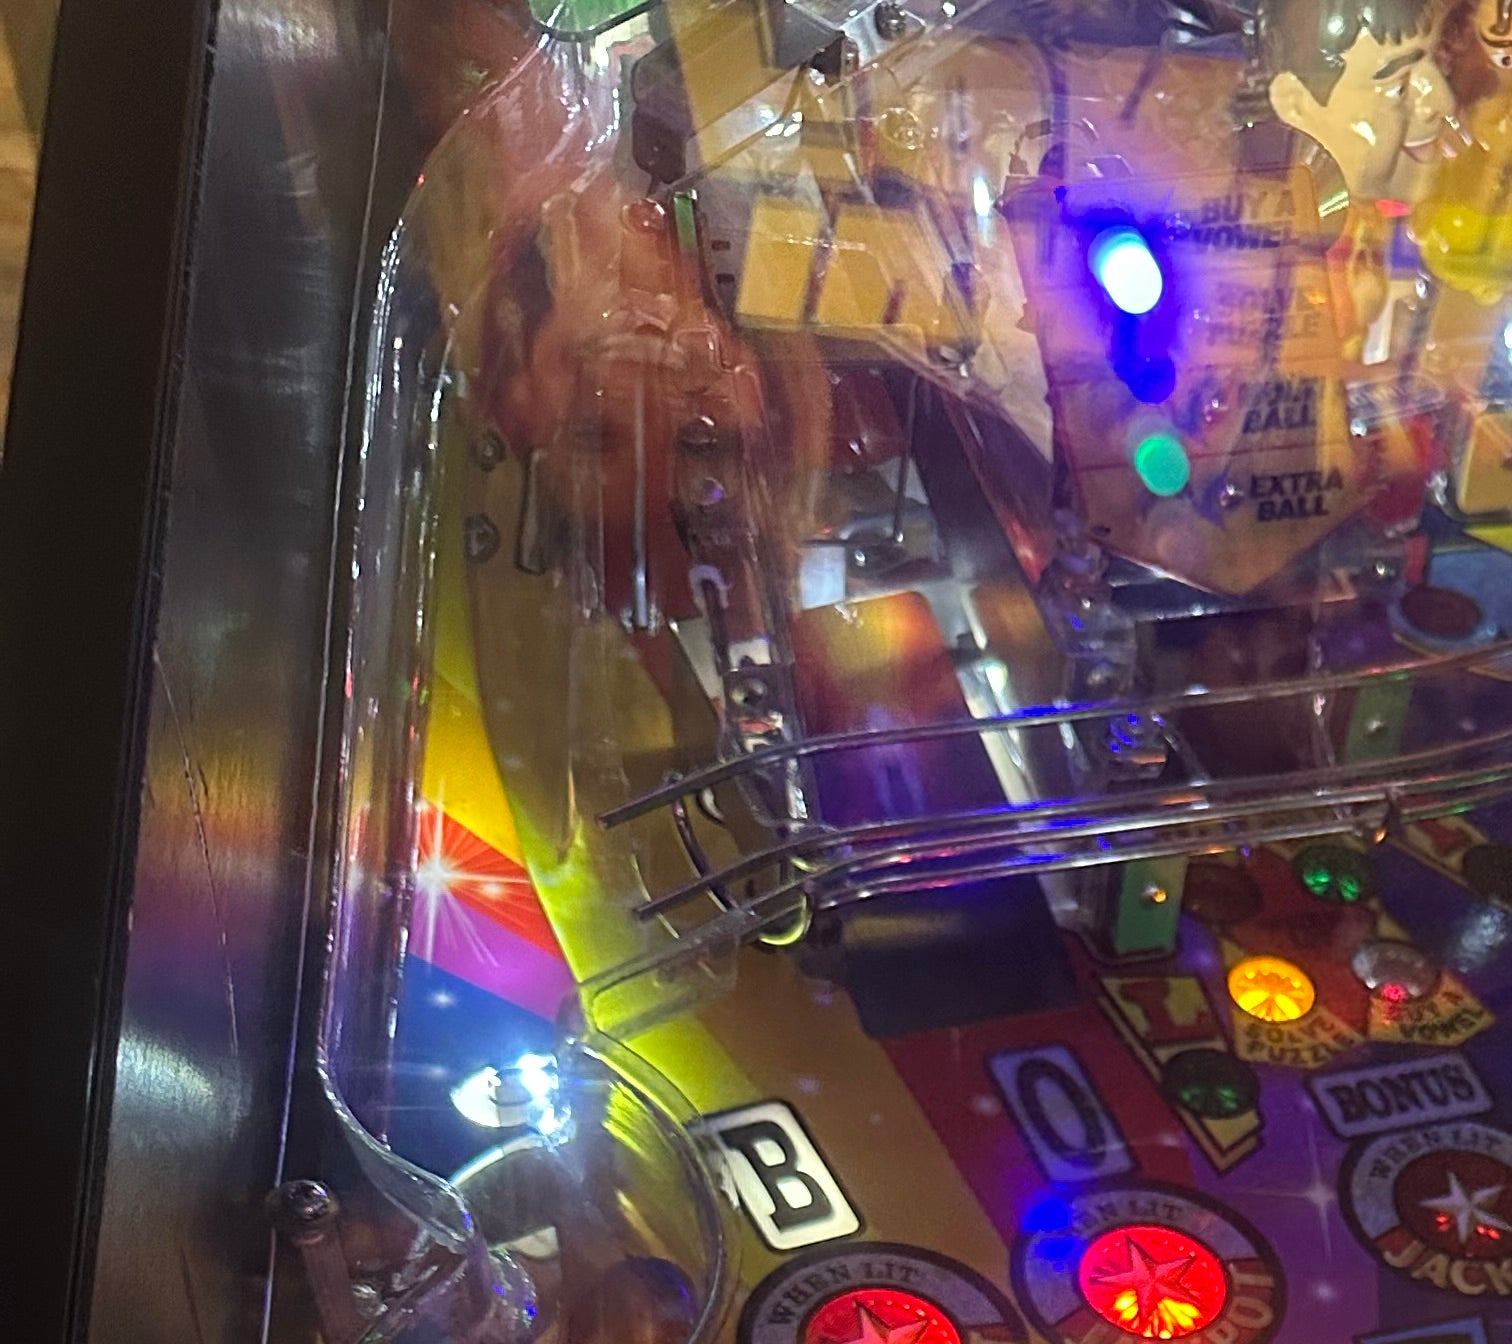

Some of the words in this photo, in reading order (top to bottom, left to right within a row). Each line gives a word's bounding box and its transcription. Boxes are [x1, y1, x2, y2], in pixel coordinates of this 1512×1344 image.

[1250, 470, 1342, 499] EXTRA
[1256, 498, 1330, 523] BALL
[1012, 1056, 1114, 1164] O
[1325, 1062, 1477, 1123] BONUS
[719, 1120, 834, 1233] B
[1371, 1129, 1454, 1186] WHEN
[1128, 1199, 1183, 1223] LIT
[768, 1262, 852, 1328] WHEN
[858, 1259, 921, 1288] LIT
